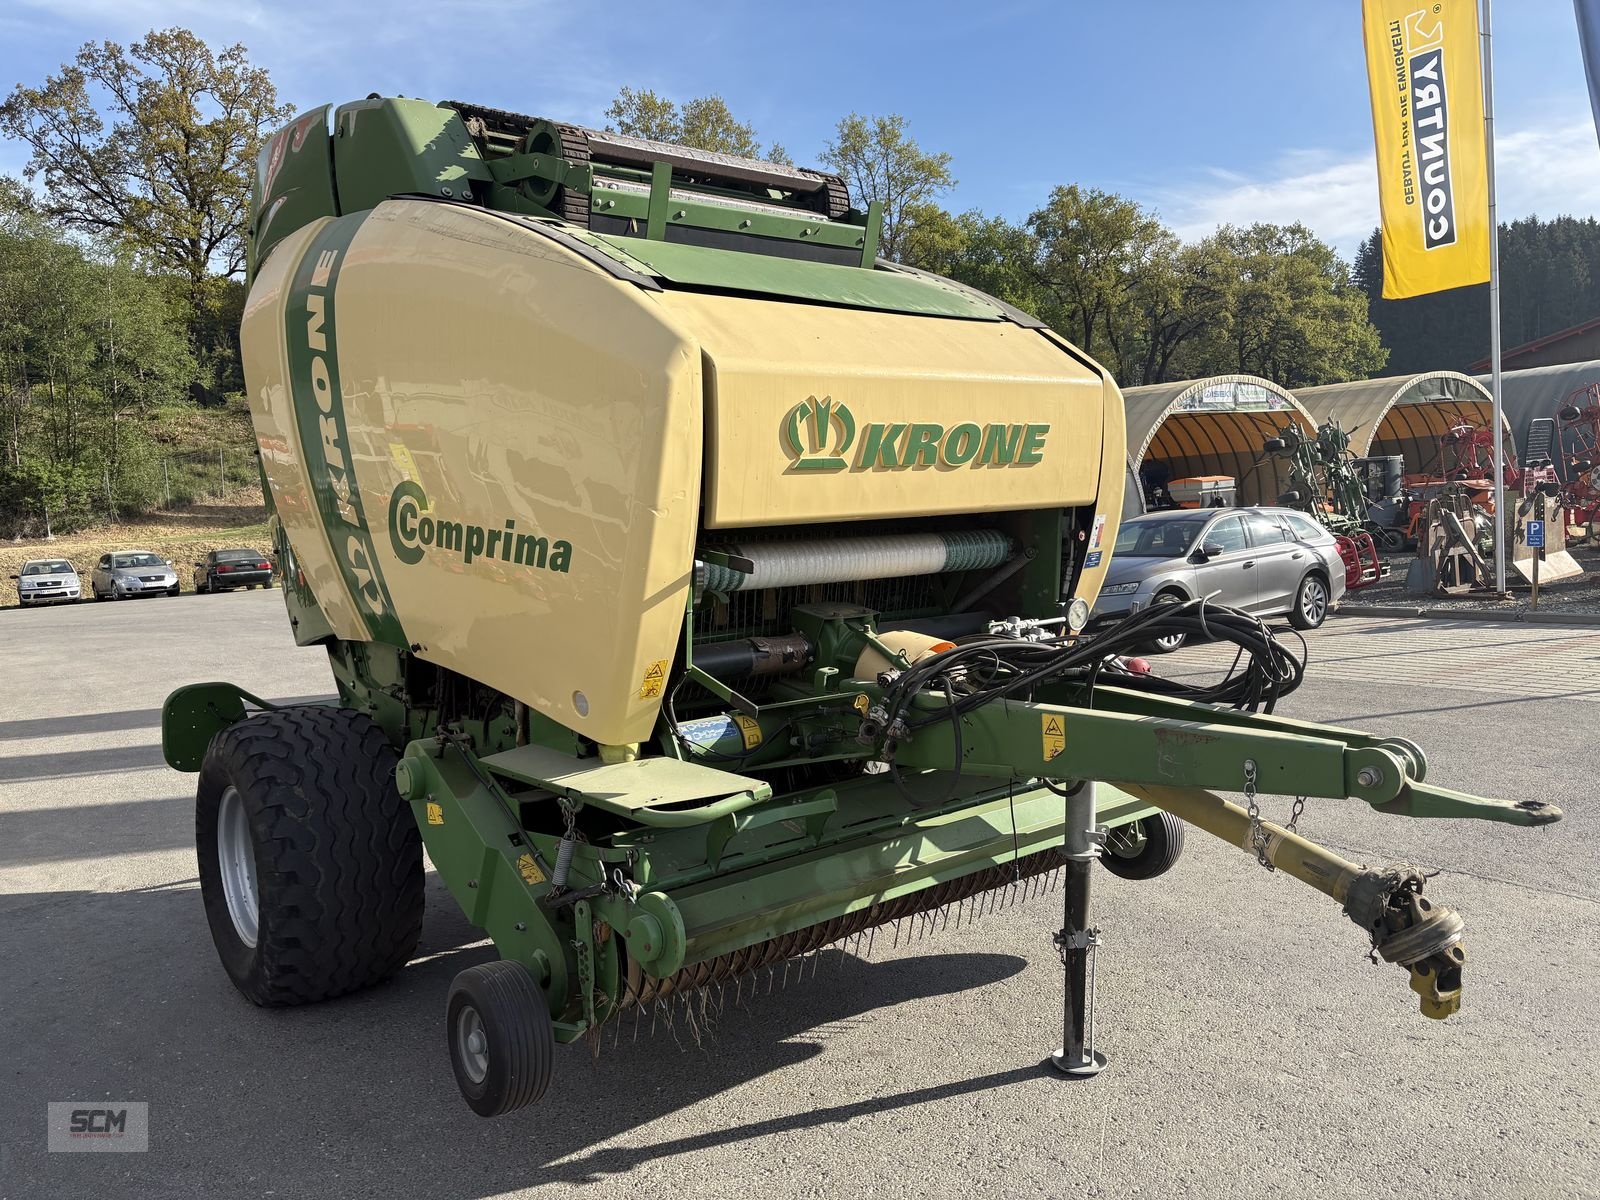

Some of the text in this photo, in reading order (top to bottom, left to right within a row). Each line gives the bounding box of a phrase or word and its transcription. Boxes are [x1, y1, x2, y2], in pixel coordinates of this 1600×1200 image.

[306, 249, 361, 528] KRONE
[850, 422, 1050, 472] KRONE
[388, 480, 573, 574] Comprima
[1530, 522, 1540, 535] P
